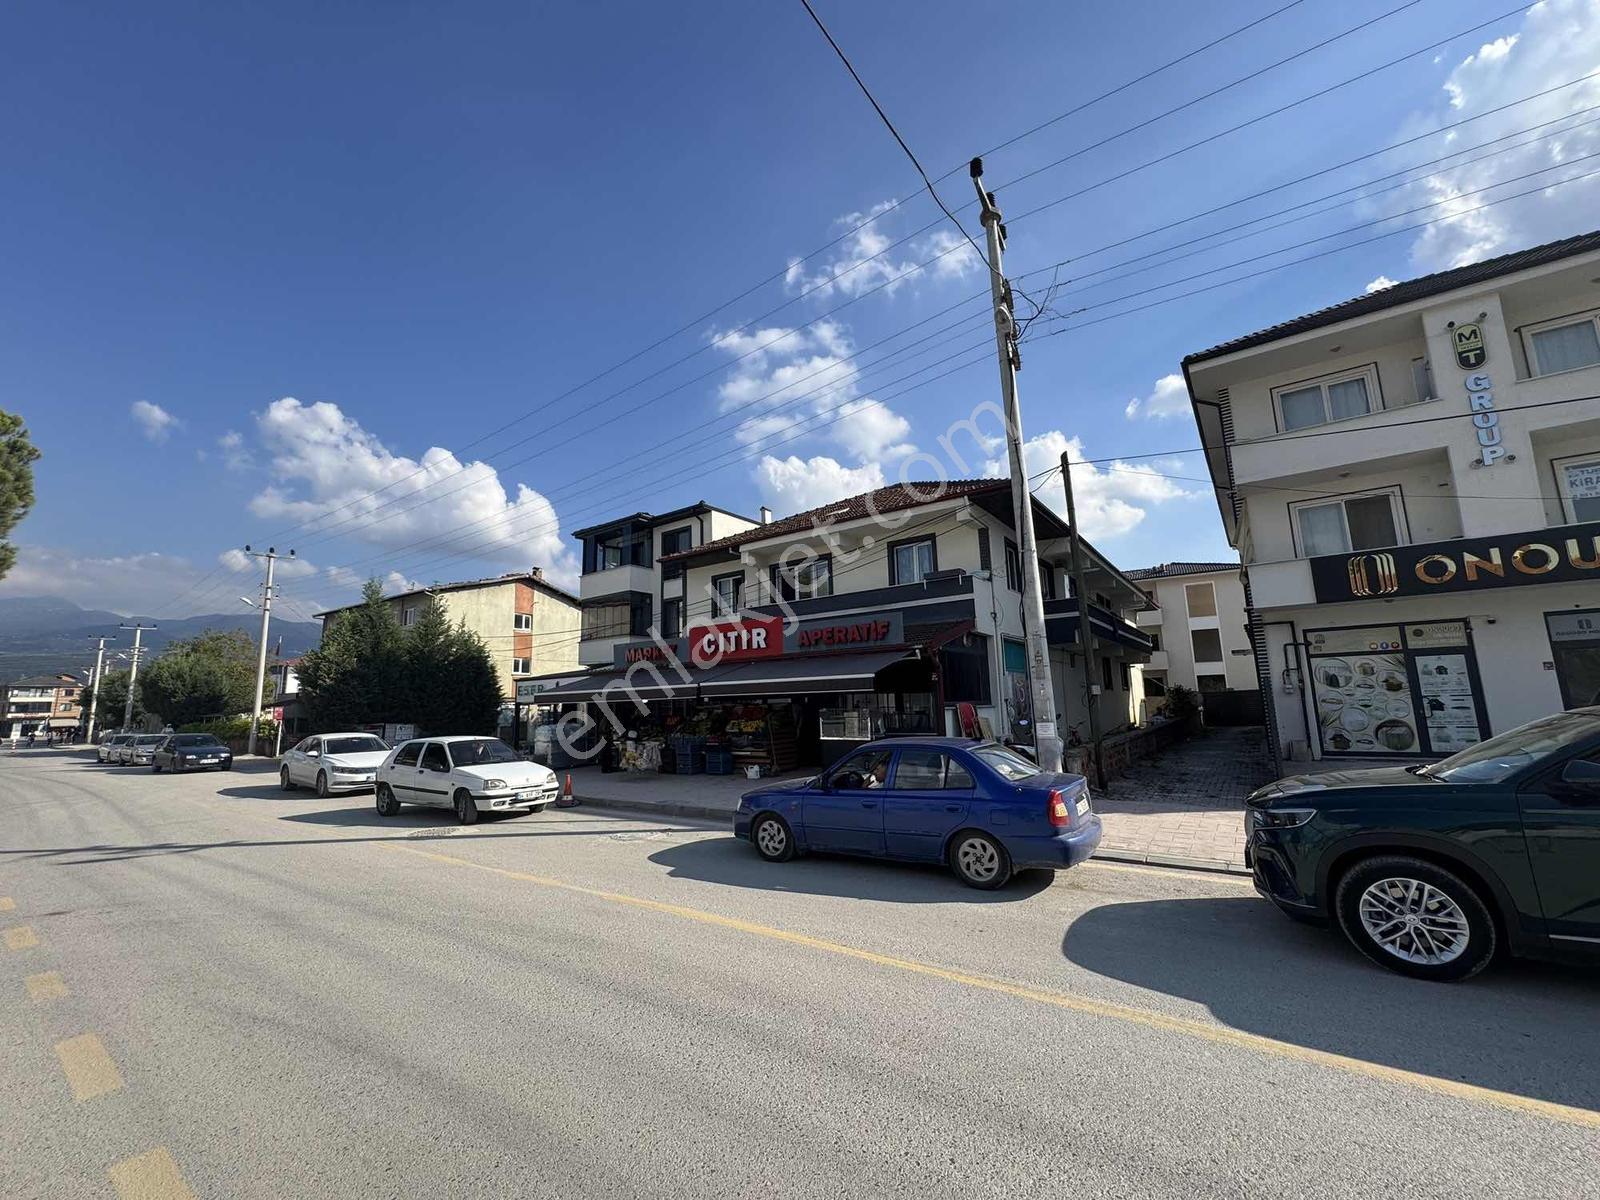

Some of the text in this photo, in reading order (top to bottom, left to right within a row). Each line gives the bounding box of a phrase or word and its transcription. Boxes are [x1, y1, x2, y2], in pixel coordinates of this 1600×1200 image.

[1465, 373, 1505, 466] GROUP
[703, 628, 766, 655] ÇITIR
[798, 620, 890, 646] APERATİF
